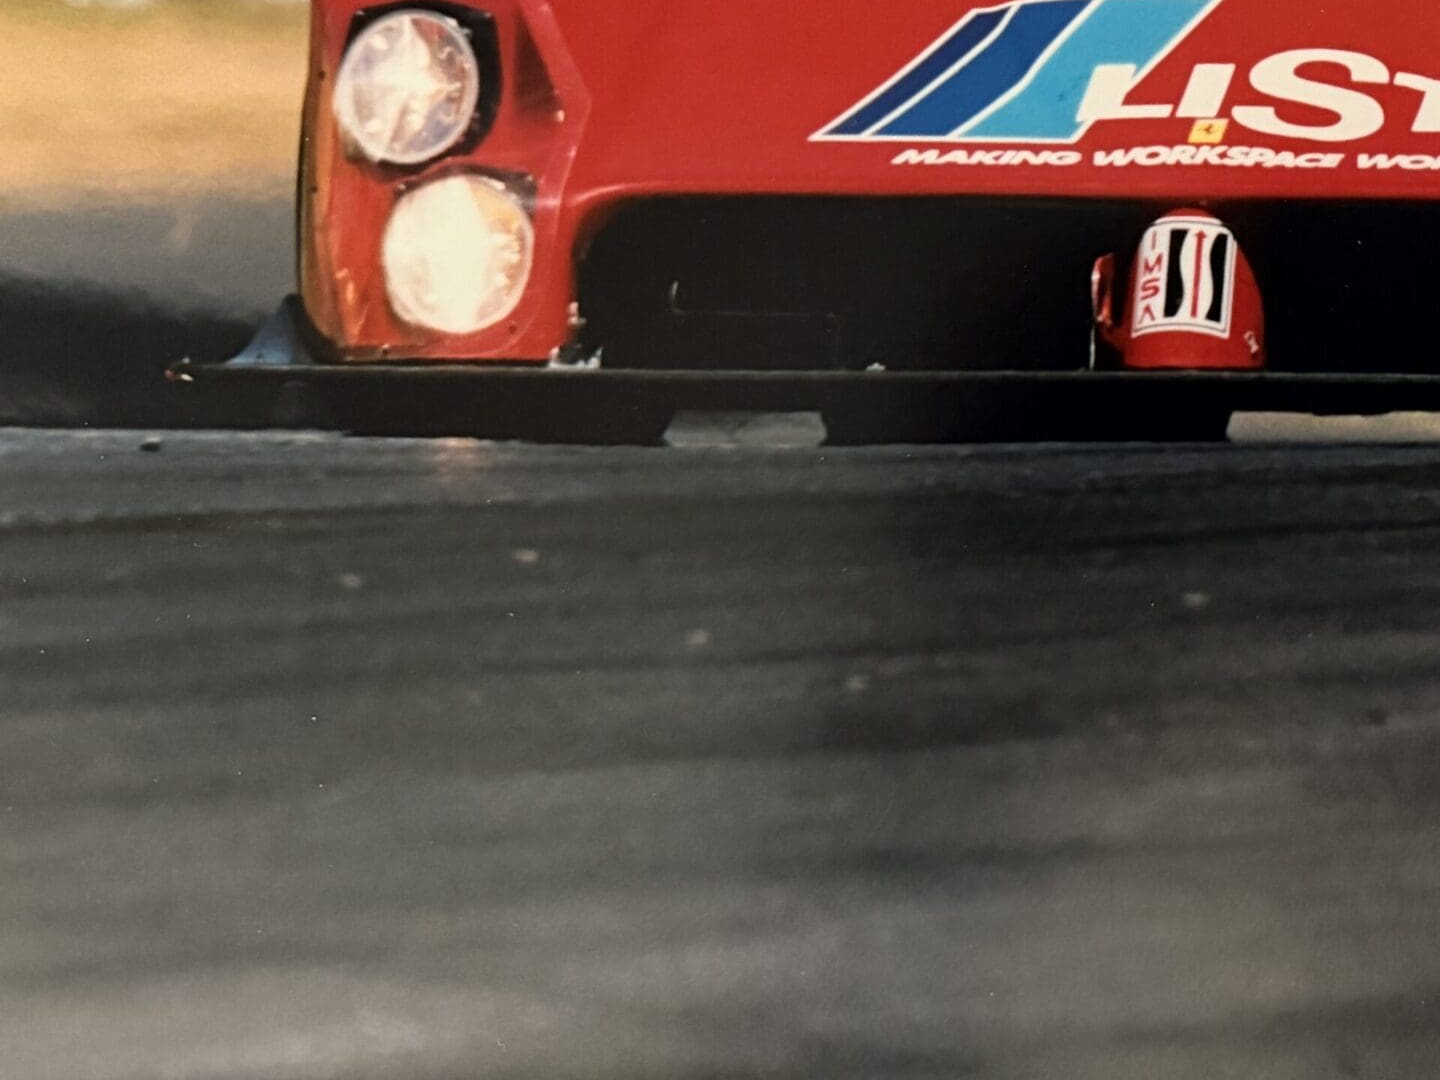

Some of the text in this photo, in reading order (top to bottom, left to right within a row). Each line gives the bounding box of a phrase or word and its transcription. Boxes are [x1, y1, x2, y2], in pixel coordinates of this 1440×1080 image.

[890, 148, 1082, 168] MAKING
[1092, 145, 1345, 169] WORKSPACE
[1138, 230, 1162, 325] IMSA
